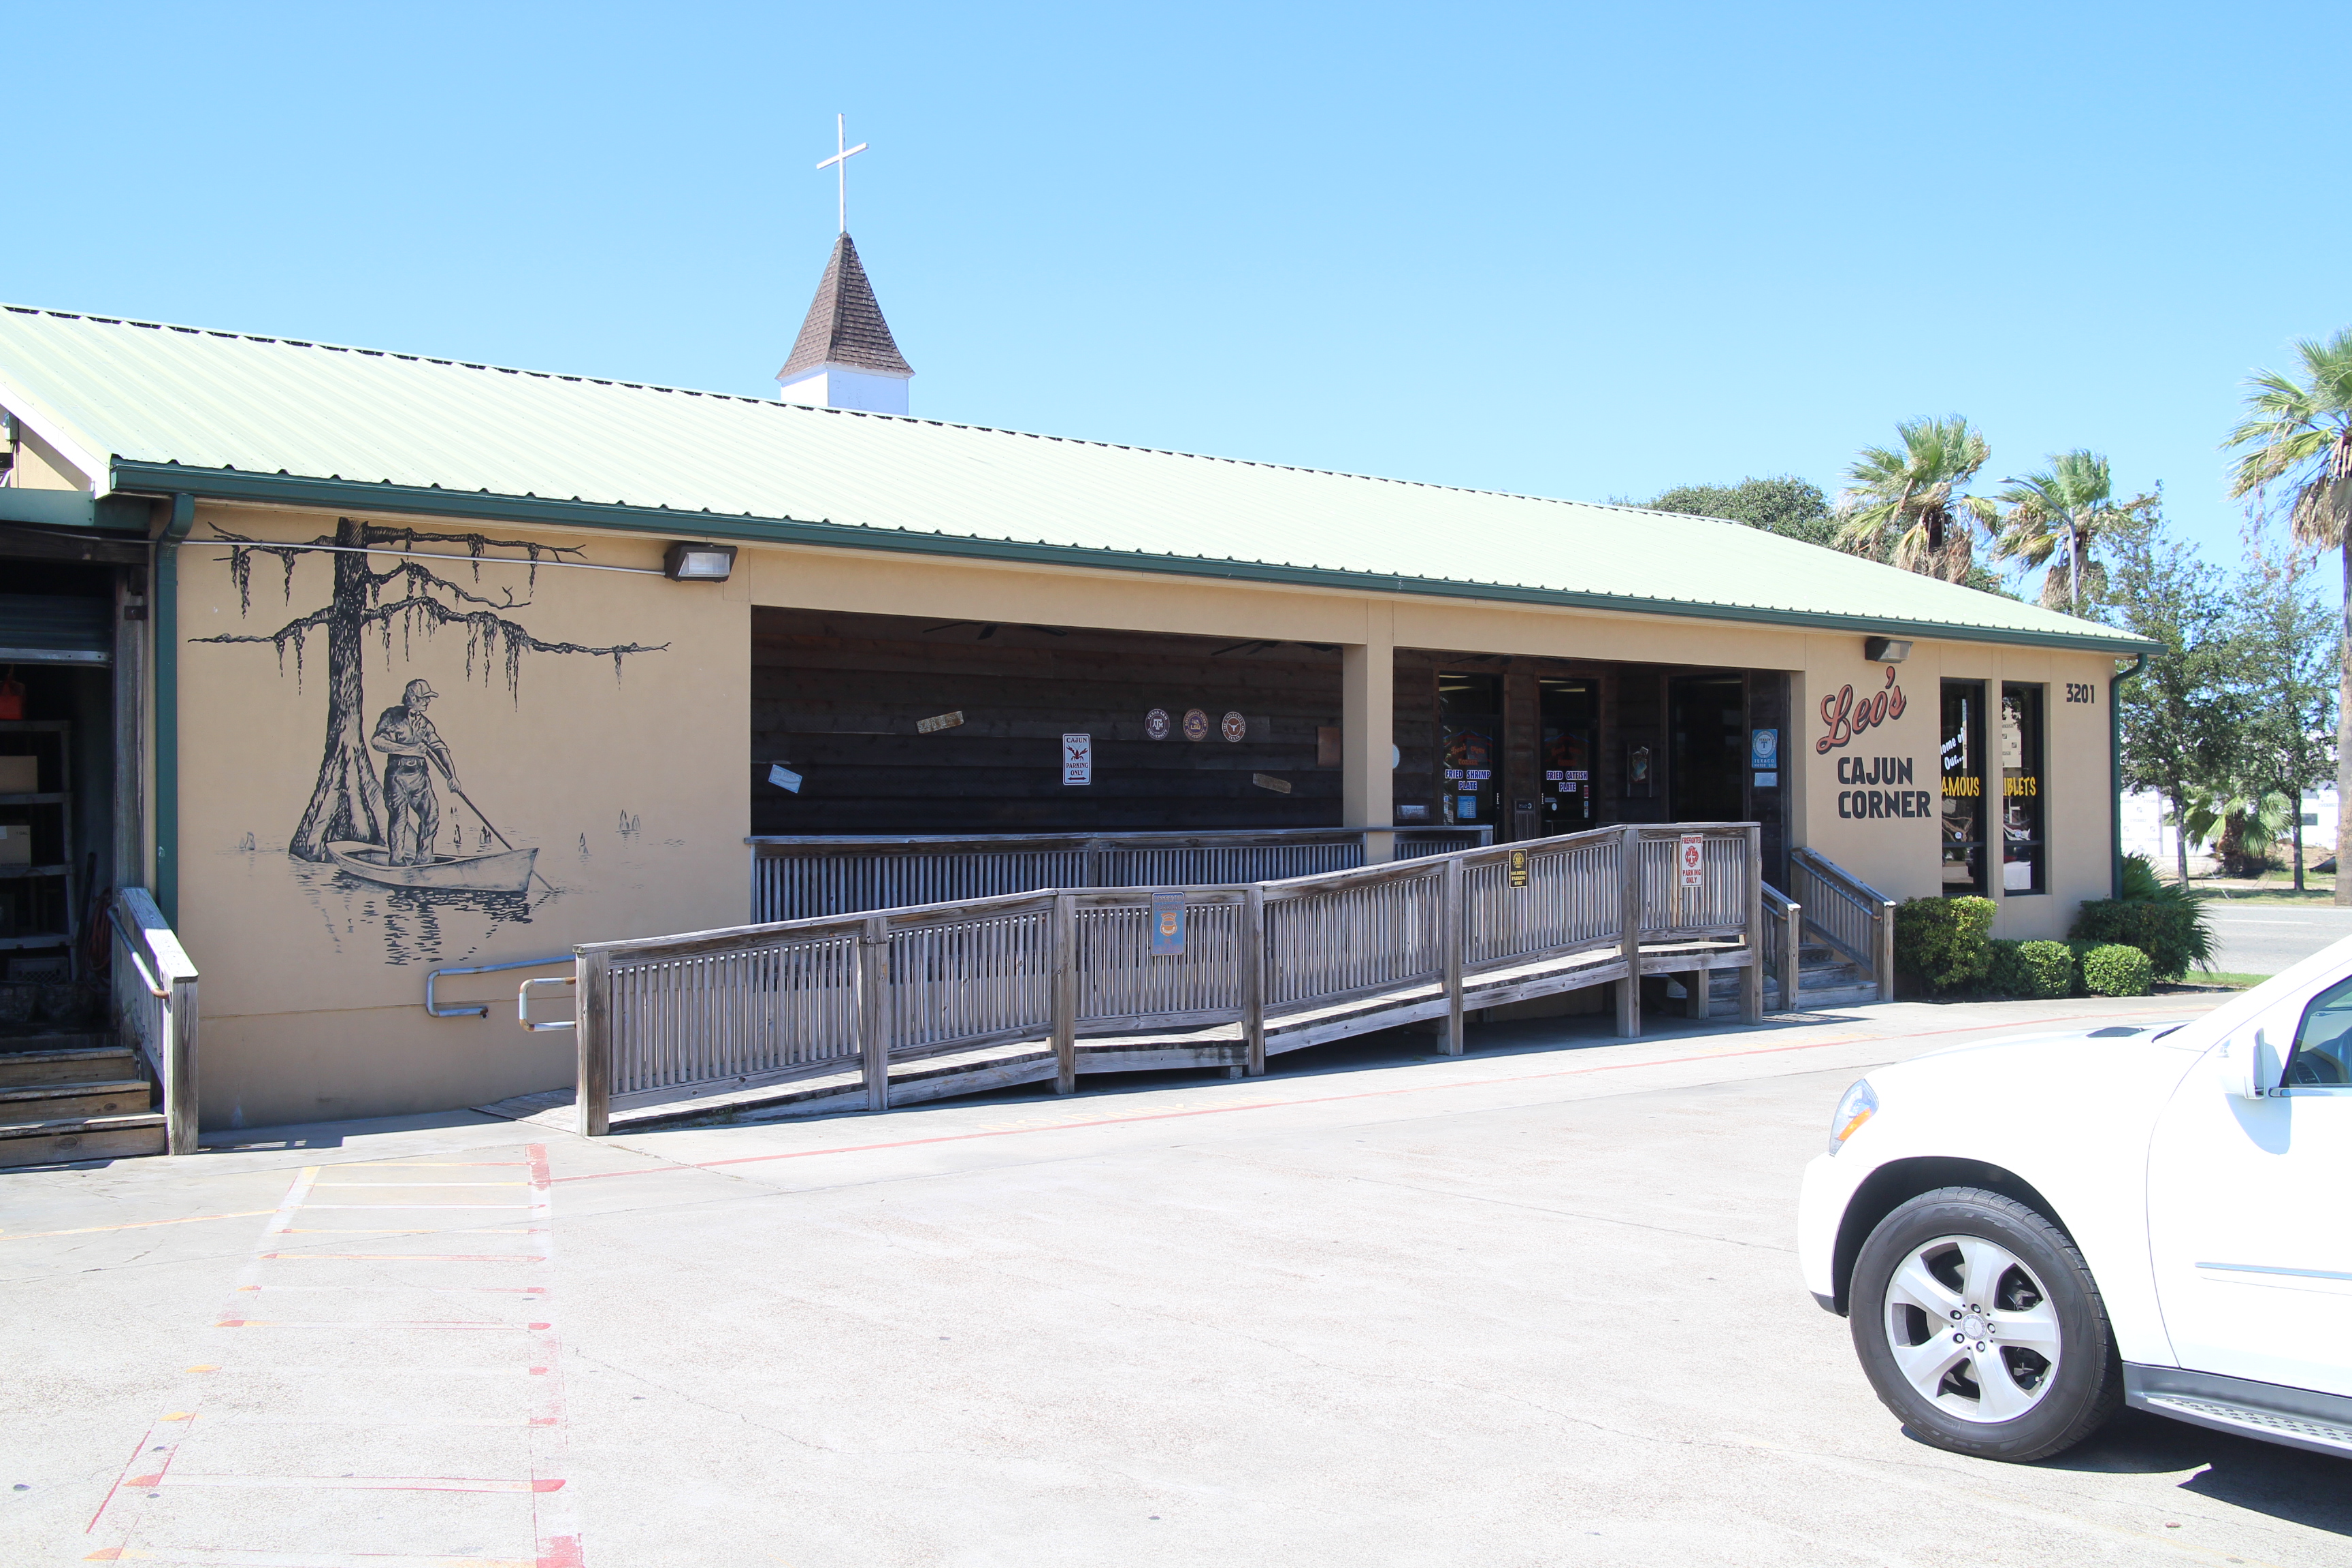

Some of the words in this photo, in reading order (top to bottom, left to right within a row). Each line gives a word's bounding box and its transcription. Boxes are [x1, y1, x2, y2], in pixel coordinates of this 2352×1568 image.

[2066, 683, 2094, 704] 3201
[1147, 710, 1160, 720] TEXAS
[1816, 666, 1907, 755] Leo's
[1185, 710, 1199, 726] LOUISIANA
[1225, 713, 1243, 724] UNIVERSITY
[1147, 728, 1168, 738] UNIVERSITY
[1186, 729, 1205, 738] UNIVERSITY
[1940, 737, 1957, 755] ome
[1957, 727, 1965, 744] of
[1445, 769, 1463, 779] FRIED
[1466, 770, 1491, 779] SHRIMP
[1546, 770, 1563, 780] FRIED
[1565, 770, 1588, 781] CATFISH
[1838, 756, 1913, 785] CAJUN
[1458, 781, 1477, 790] PLATE
[1559, 782, 1576, 791] PLATE
[1941, 776, 1980, 797] AMOUS
[2002, 777, 2036, 796] IBLETS
[1838, 789, 1931, 819] CORNER
